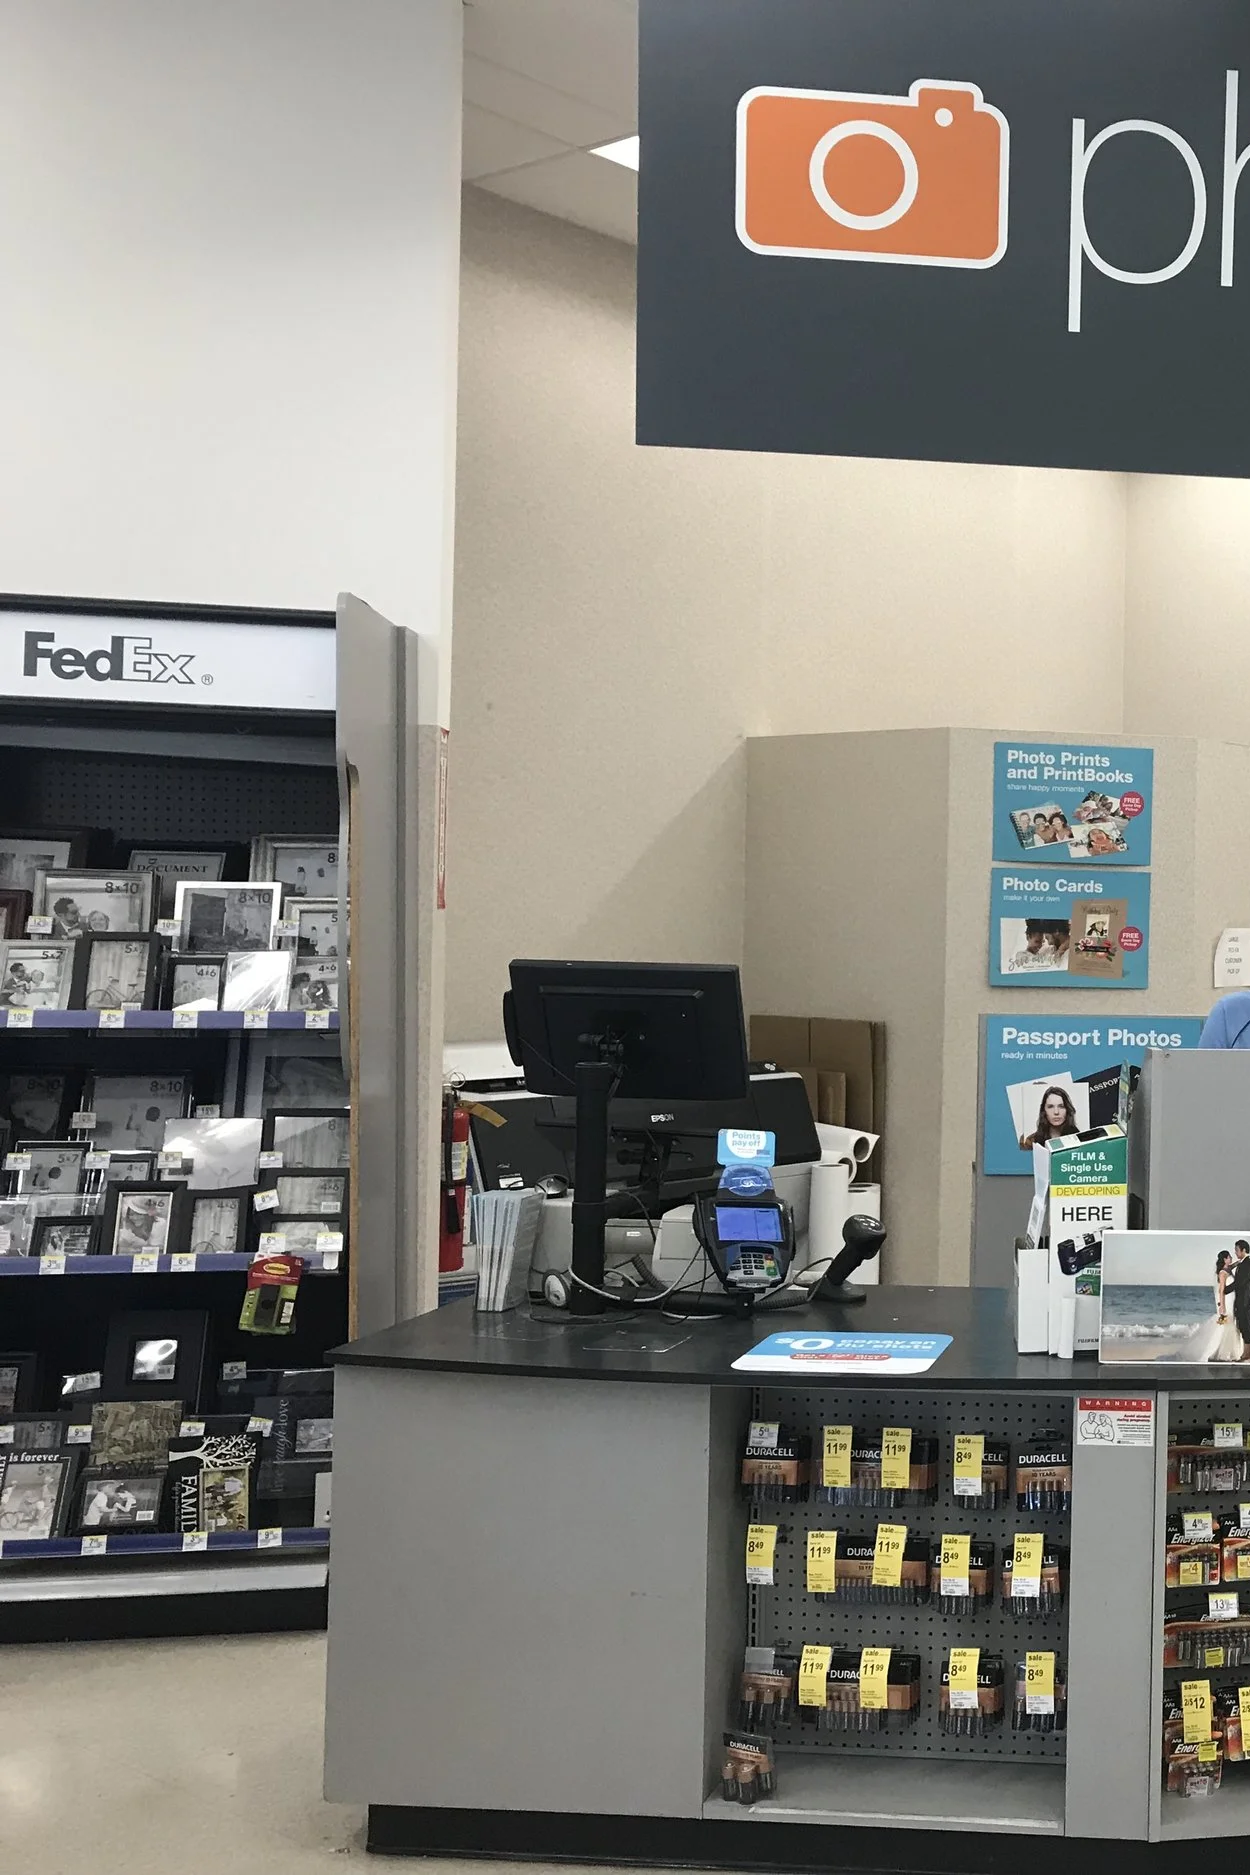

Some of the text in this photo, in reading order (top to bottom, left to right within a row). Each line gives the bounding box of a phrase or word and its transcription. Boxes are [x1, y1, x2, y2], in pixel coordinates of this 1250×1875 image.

[1007, 749, 1110, 767] Photo Prints
[1007, 766, 1133, 783] and PrintBooks
[1007, 783, 1084, 793] share happy moments
[137, 864, 208, 874] DOCUMENT
[1003, 877, 1104, 894] Photo Cards
[1003, 894, 1023, 902] make
[1024, 894, 1029, 902] it
[1030, 895, 1045, 903] your
[1002, 1027, 1182, 1049] Passport Photos
[1001, 1051, 1068, 1061] ready in minutes
[1089, 1076, 1121, 1093] ASSPOR
[651, 1113, 674, 1122] EPSON
[732, 1131, 761, 1140] Points
[1071, 1152, 1106, 1161] FILM &
[1060, 1163, 1113, 1173] Single Use
[1069, 1174, 1108, 1183] Camera
[1056, 1186, 1120, 1197] DEVELOPING
[1061, 1206, 1113, 1222] HERE
[9, 1453, 59, 1462] is forever
[746, 1448, 794, 1457] DURACELL
[1019, 1454, 1067, 1464] DURACELL
[847, 1548, 875, 1557] DURA
[729, 1741, 760, 1753] DURACELL
